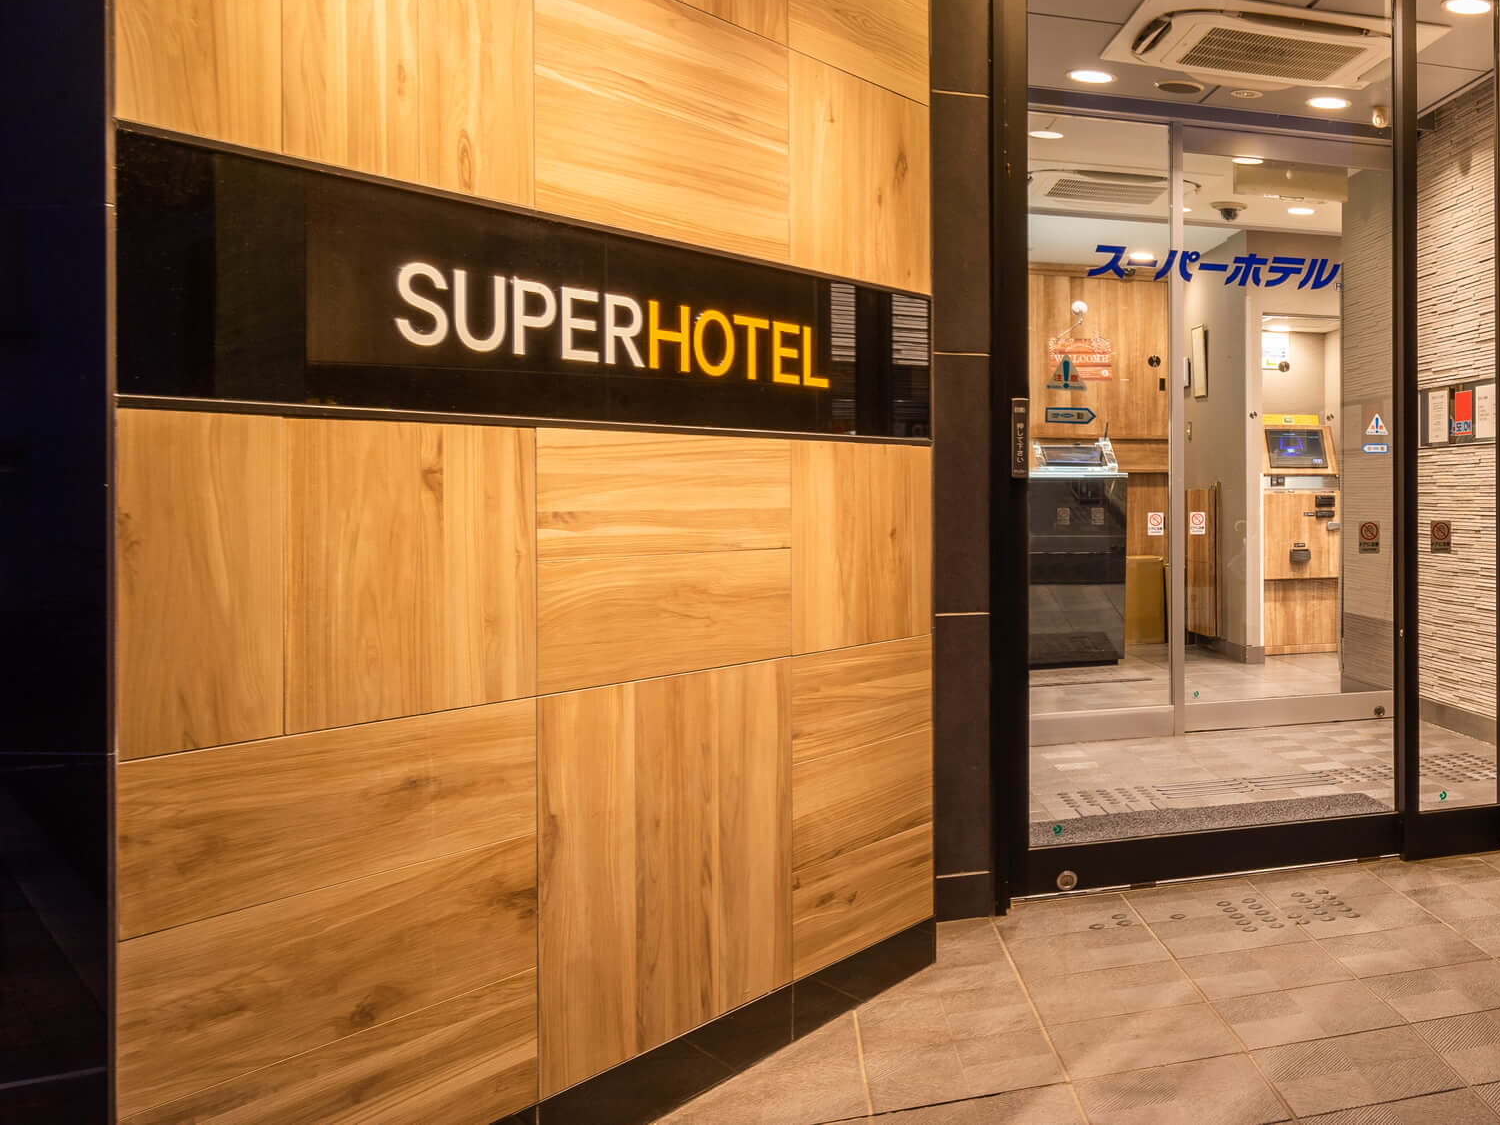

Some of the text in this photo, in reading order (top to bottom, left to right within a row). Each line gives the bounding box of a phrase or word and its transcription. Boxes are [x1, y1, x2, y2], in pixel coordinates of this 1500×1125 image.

[1087, 244, 1341, 290] スーパーホテル
